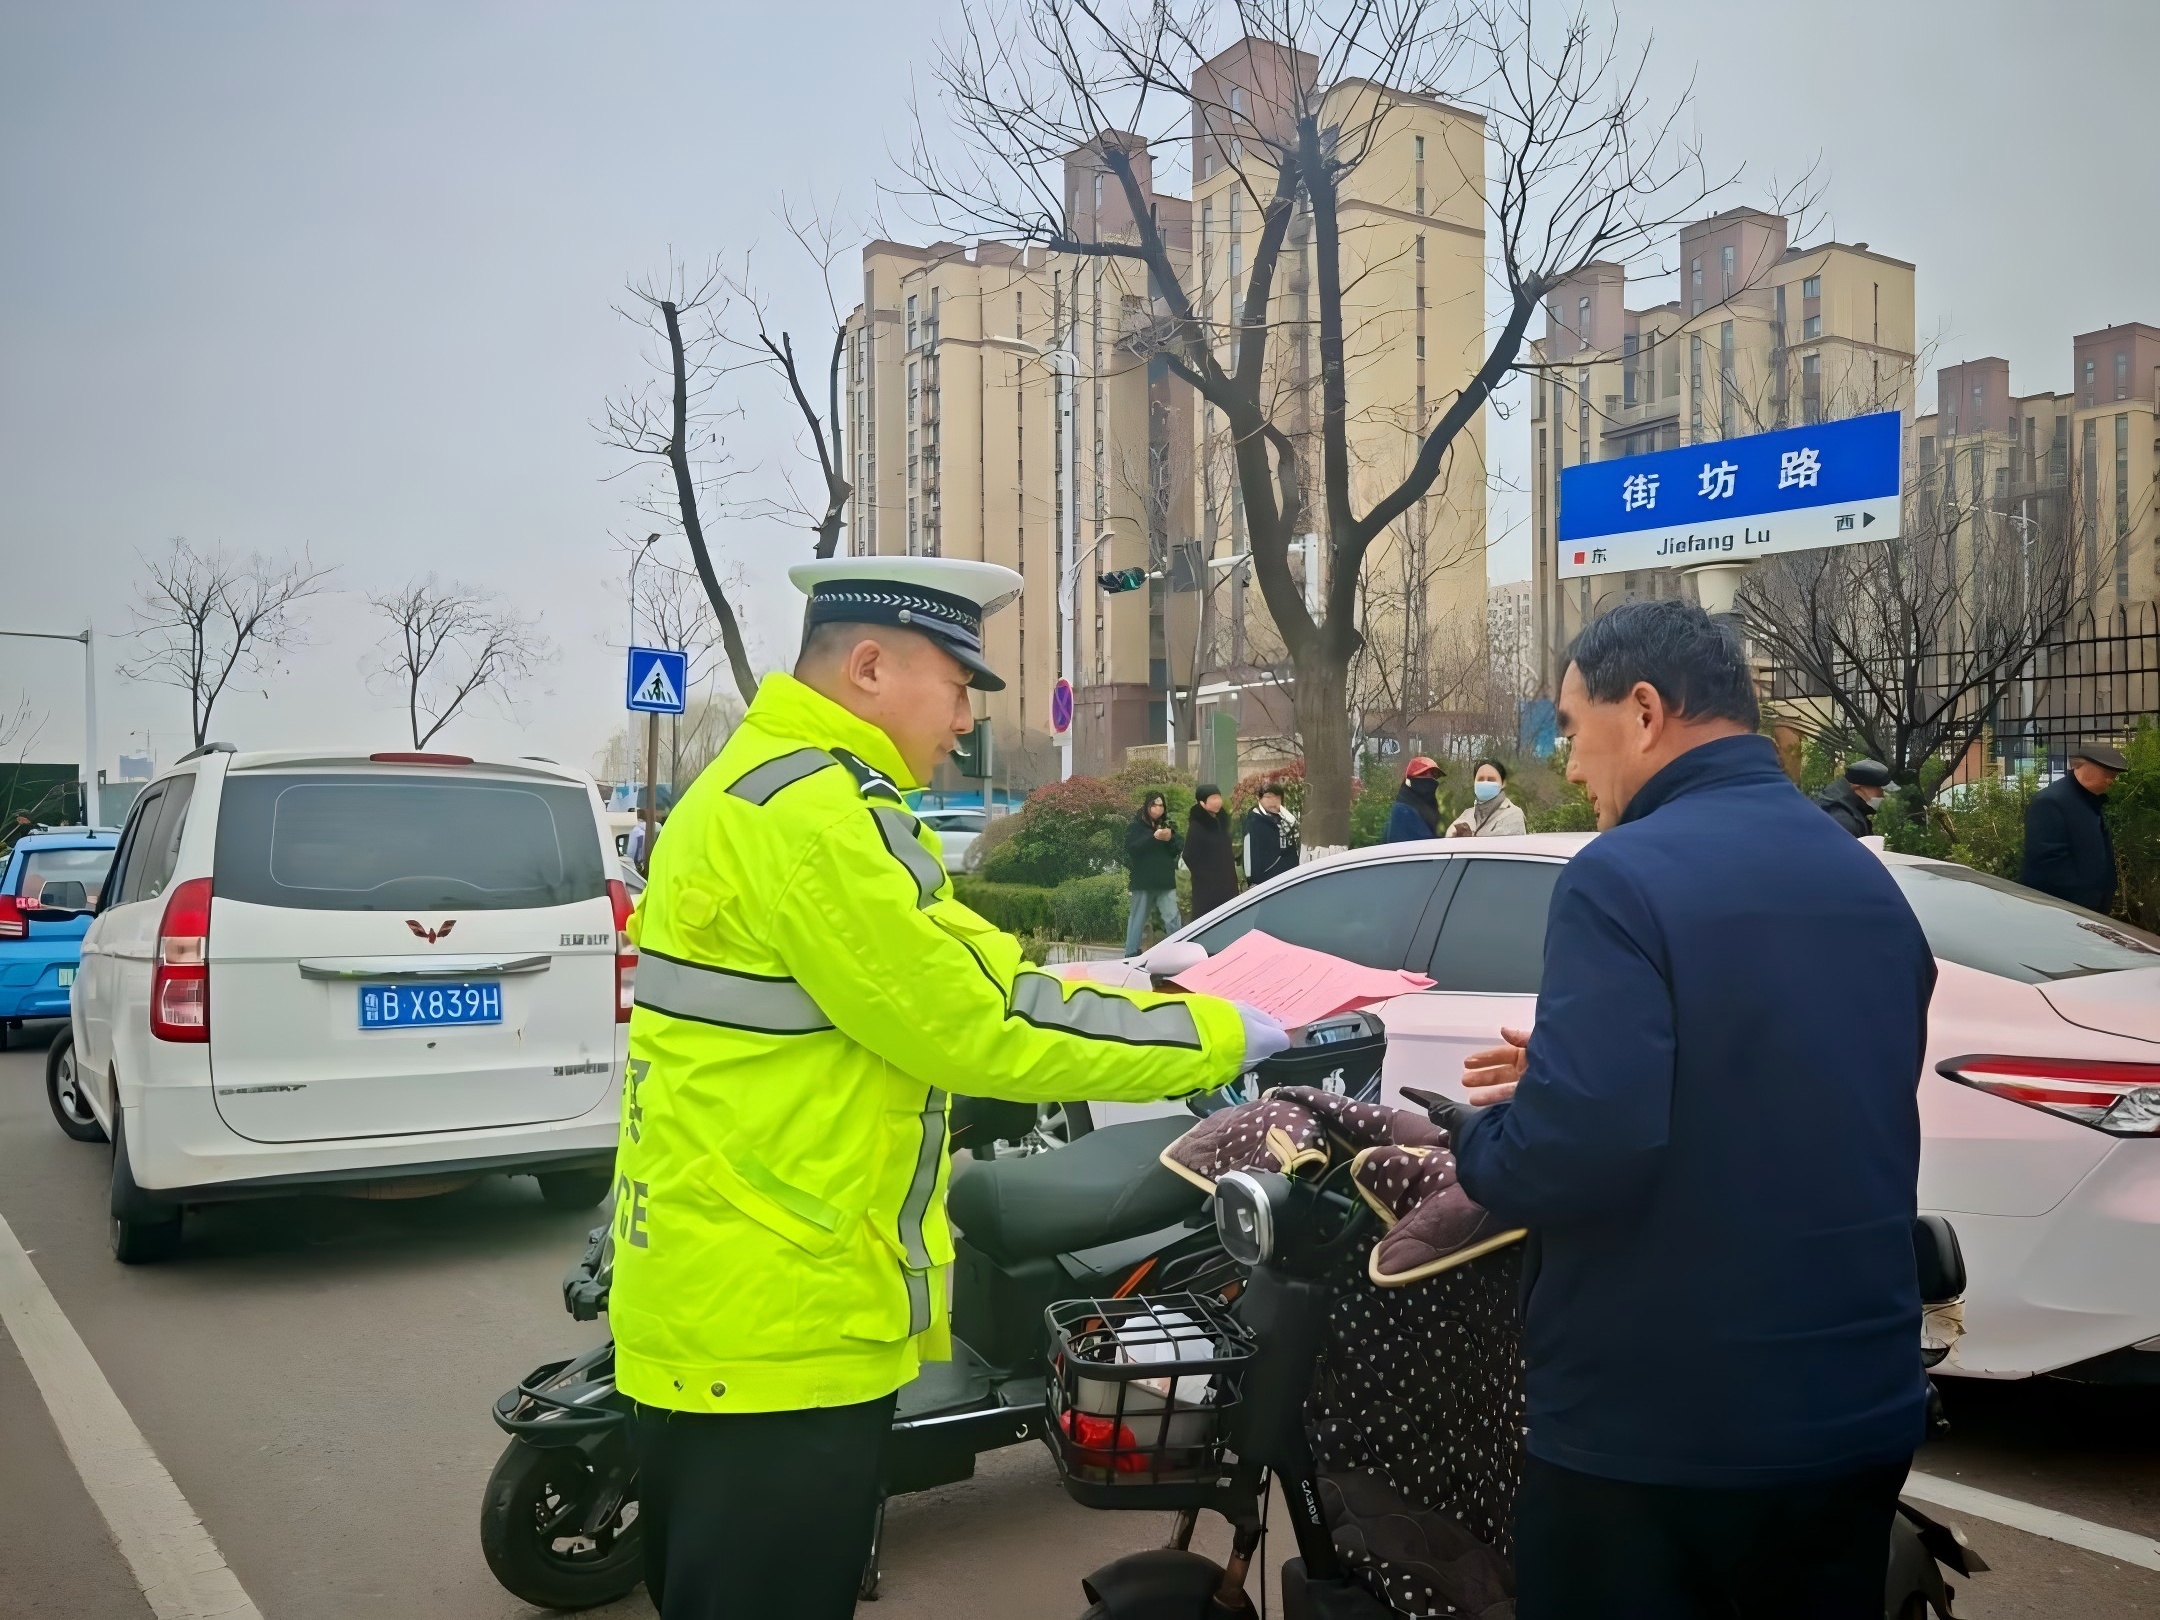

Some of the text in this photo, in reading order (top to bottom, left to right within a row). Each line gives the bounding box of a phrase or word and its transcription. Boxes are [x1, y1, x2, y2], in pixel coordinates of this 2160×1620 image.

[1622, 447, 1822, 512] 街坊路
[1833, 513, 1854, 532] 西
[1656, 527, 1771, 556] Jiefang Lu
